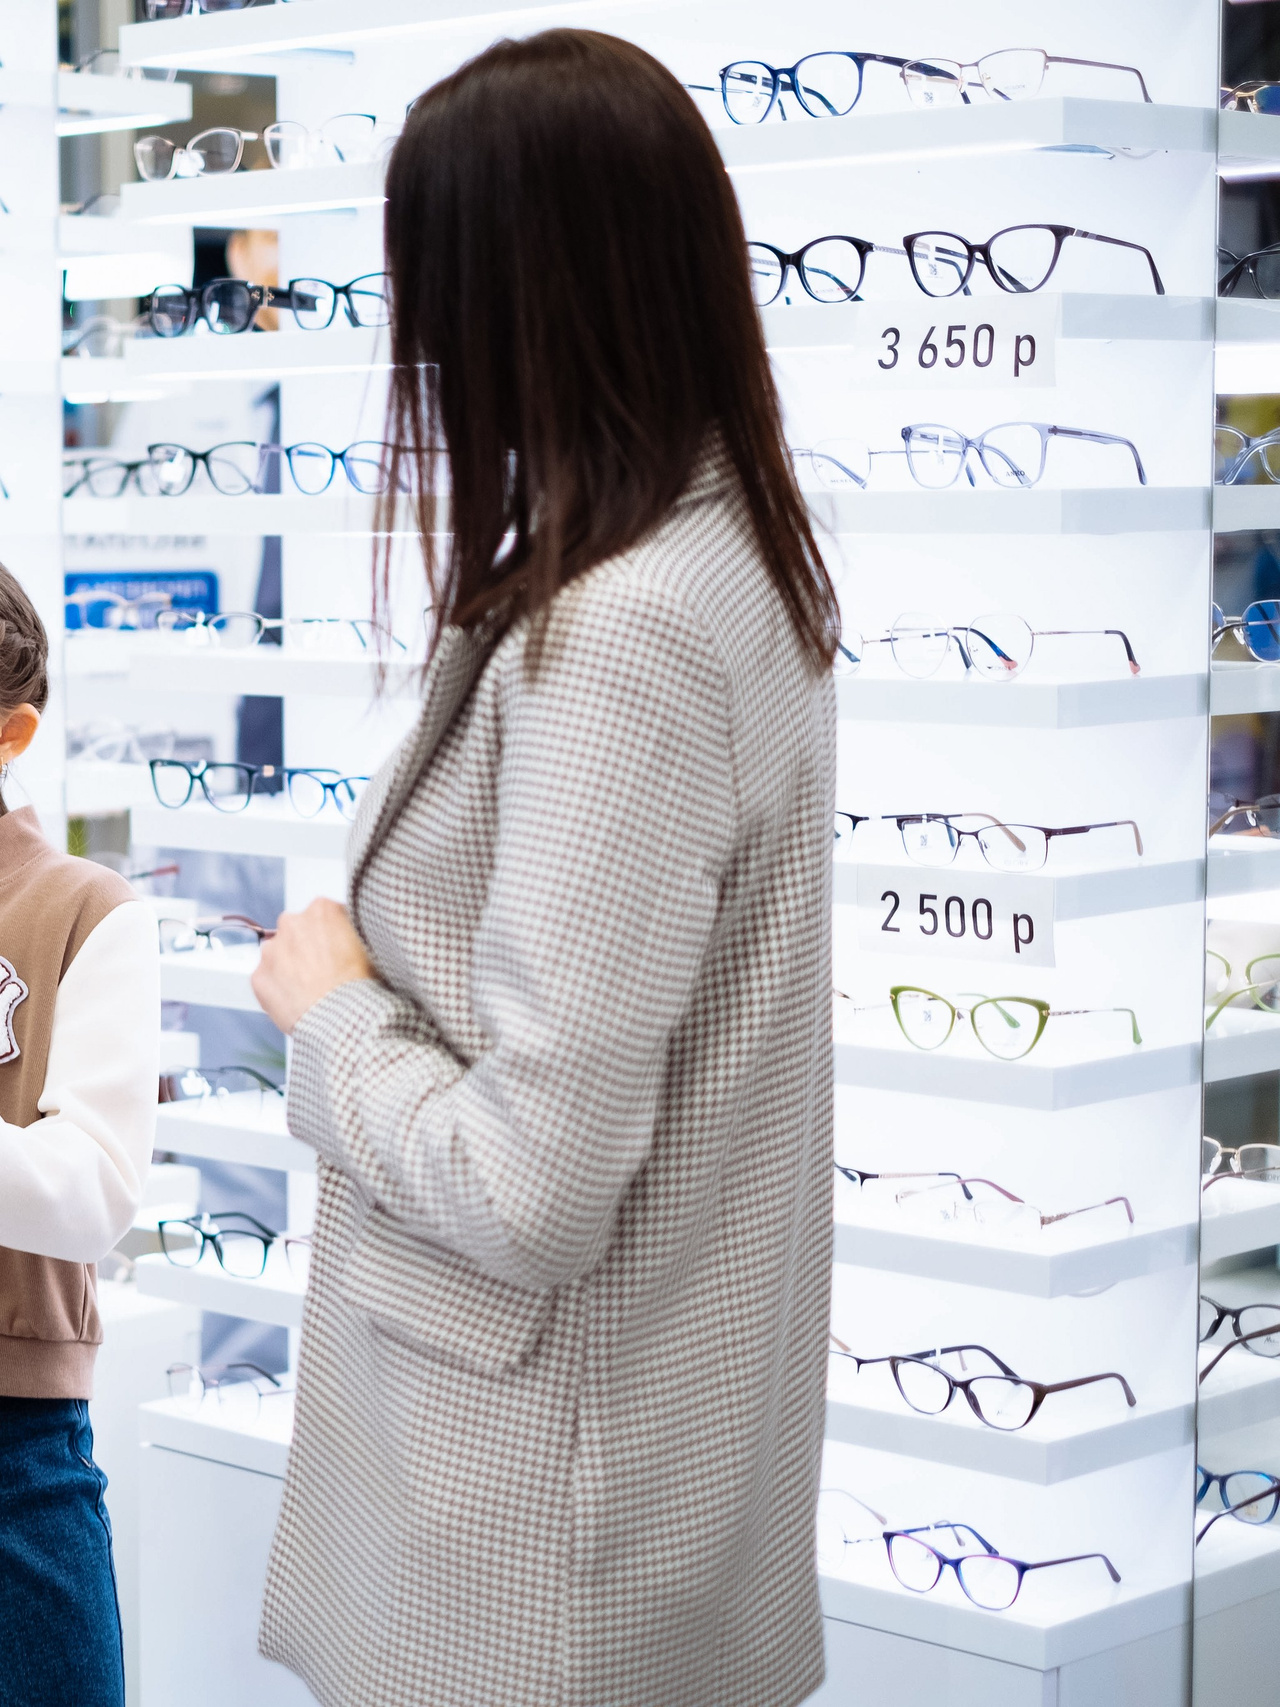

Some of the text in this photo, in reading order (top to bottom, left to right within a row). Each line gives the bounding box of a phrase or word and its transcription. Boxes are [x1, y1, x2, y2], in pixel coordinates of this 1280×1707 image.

[877, 326, 901, 370] 3
[918, 323, 995, 369] 650
[880, 890, 901, 932] 2
[919, 893, 993, 940] 500
